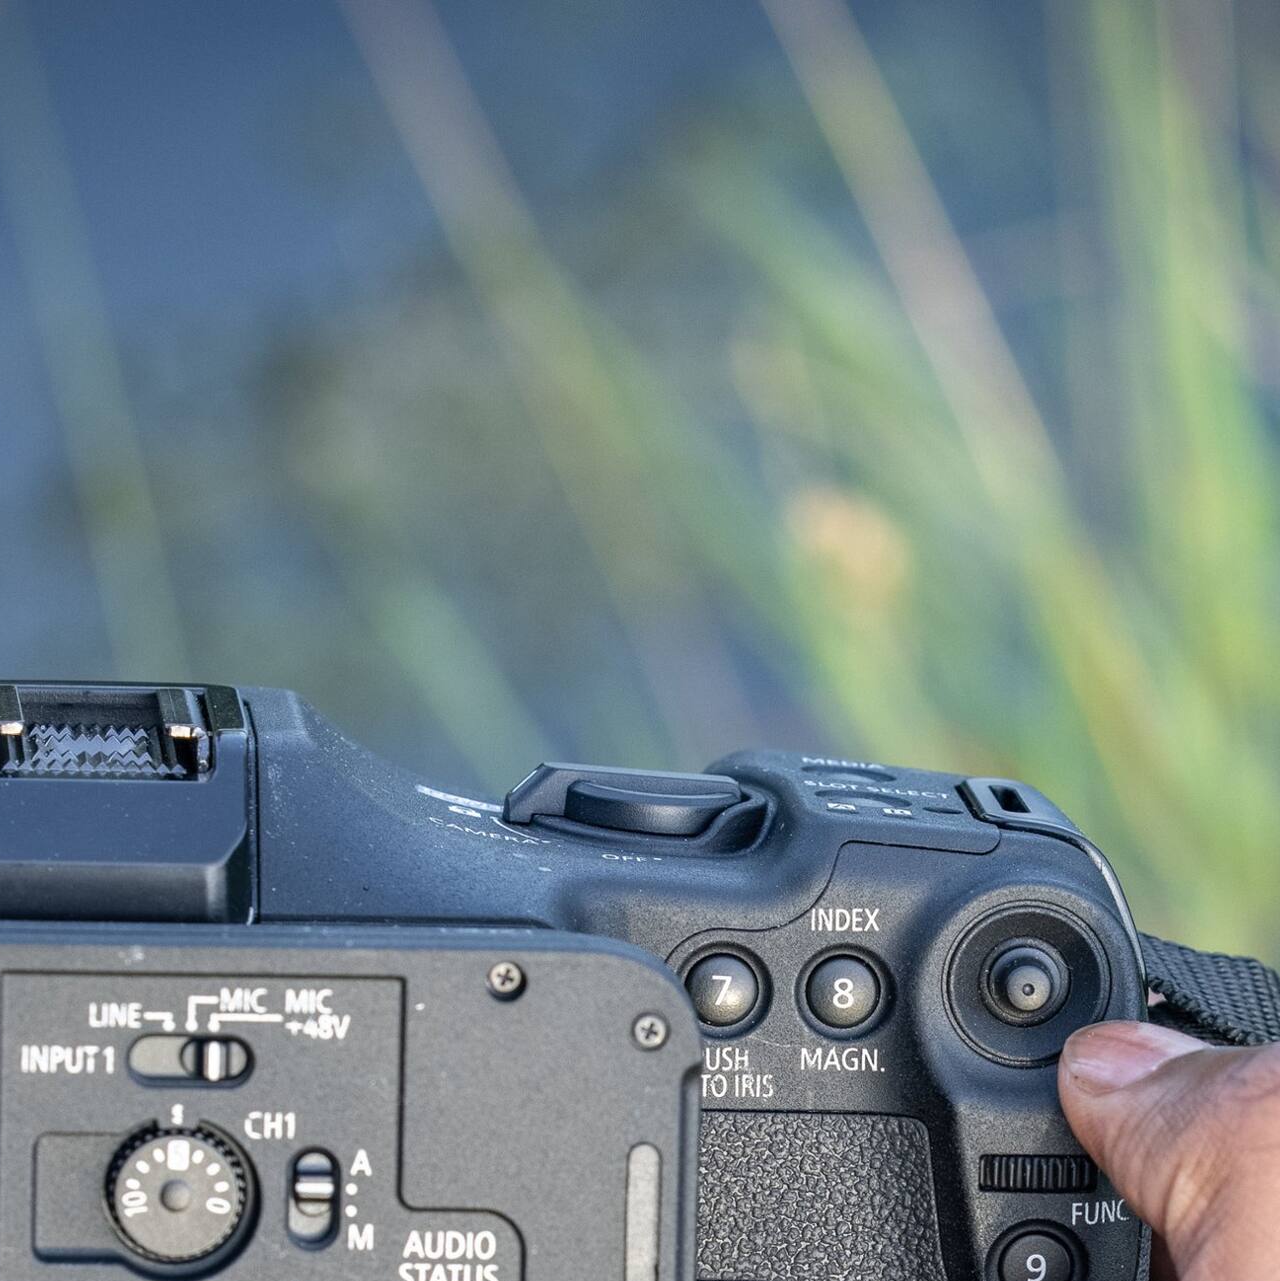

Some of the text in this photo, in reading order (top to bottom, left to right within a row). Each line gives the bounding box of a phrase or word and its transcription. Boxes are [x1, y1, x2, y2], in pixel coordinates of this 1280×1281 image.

[803, 779, 950, 799] SLOT SELECT
[429, 816, 539, 845] CAMERA
[810, 907, 880, 932] INDEX
[219, 987, 268, 1014] MIC
[284, 988, 333, 1014] MIC
[711, 975, 732, 1007] 7
[832, 977, 855, 1008] 8
[88, 1002, 142, 1029] LINE
[285, 1014, 351, 1040] +48V
[704, 1046, 750, 1072] USH
[800, 1047, 886, 1072] MAGN.
[701, 1074, 774, 1099] TO IRIS
[244, 1111, 296, 1140] CH1
[350, 1148, 373, 1177] A
[121, 1190, 149, 1218] 10
[205, 1196, 231, 1215] 0
[1071, 1198, 1129, 1226] FUNC
[347, 1223, 375, 1251] M
[402, 1230, 497, 1261] AUDIO
